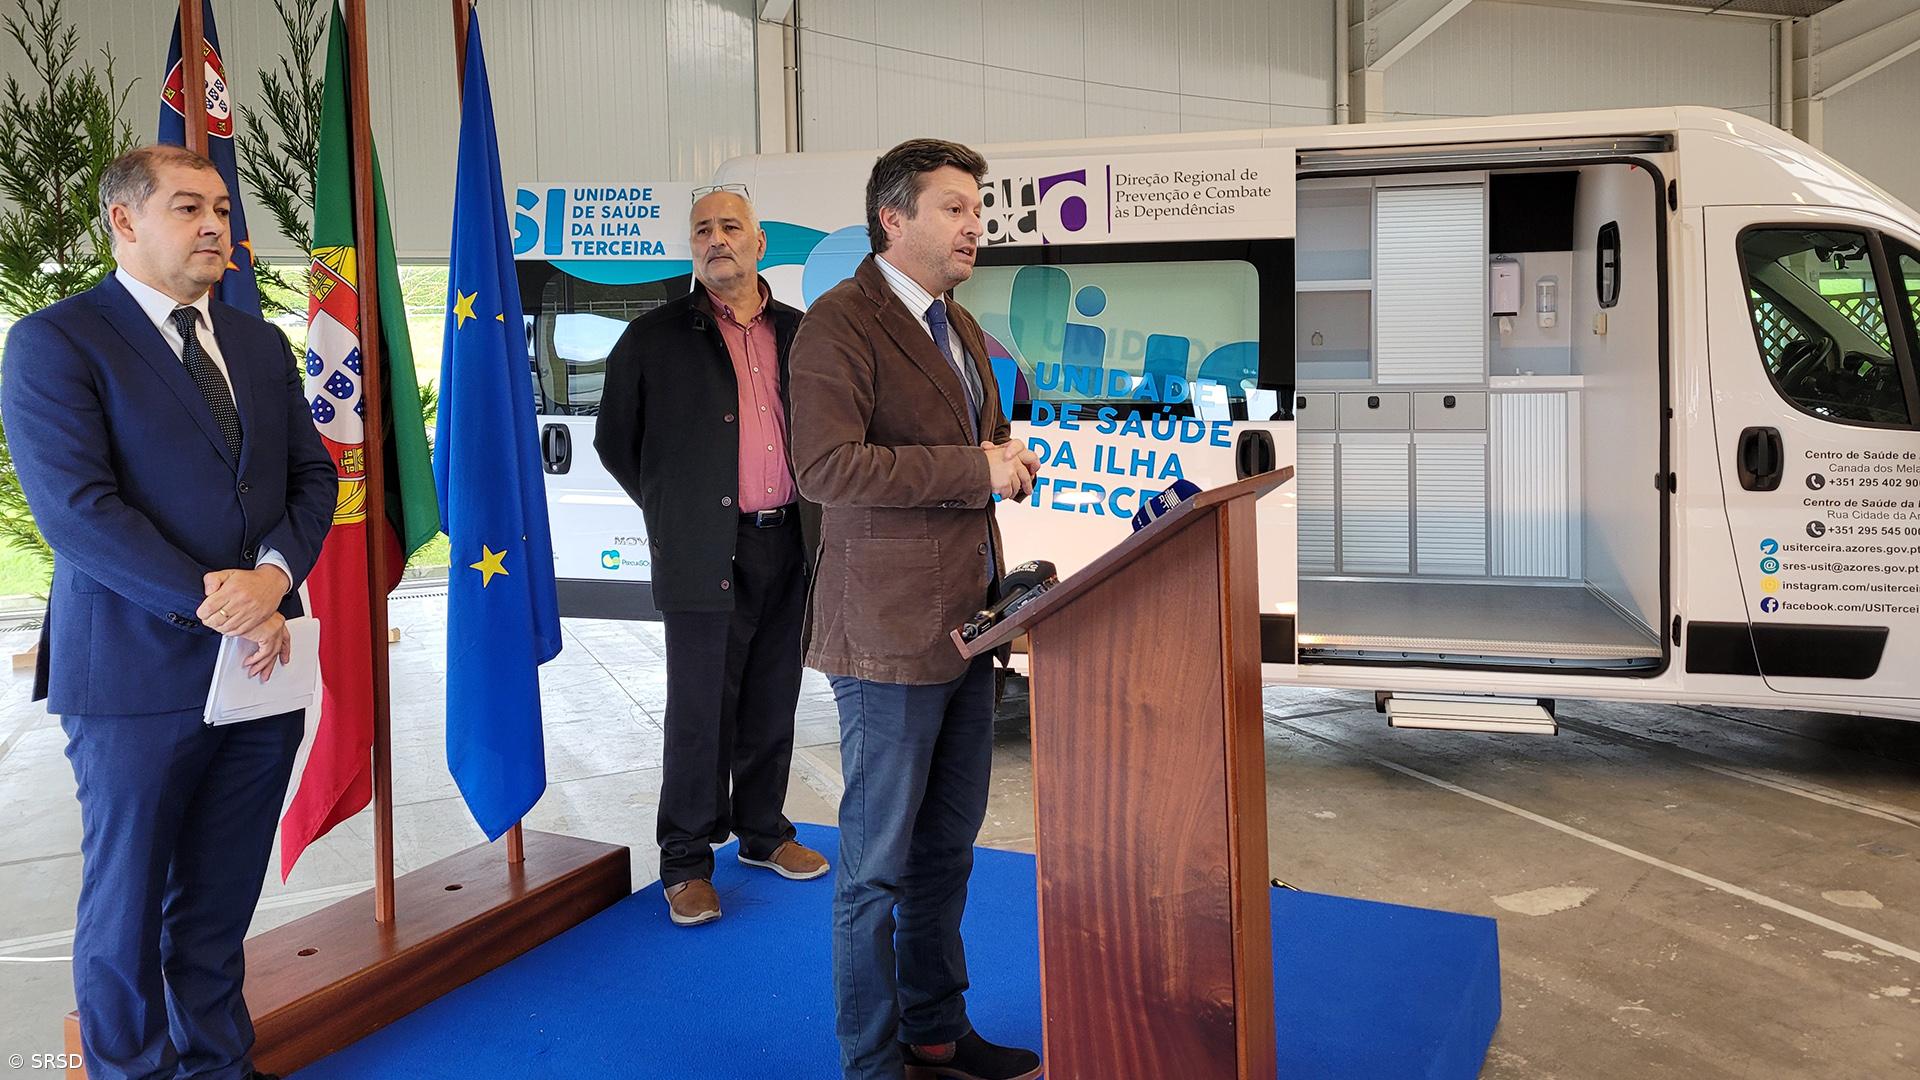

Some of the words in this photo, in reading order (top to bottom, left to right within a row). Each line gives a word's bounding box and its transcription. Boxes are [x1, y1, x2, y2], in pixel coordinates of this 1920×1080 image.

[1115, 172, 1169, 187] Direção
[1173, 168, 1236, 187] Regional
[1240, 168, 1259, 181] de
[573, 188, 653, 201] UNIDADE
[1115, 189, 1189, 204] Prevenção
[1193, 191, 1201, 200] e
[1205, 184, 1272, 199] Combate
[572, 206, 595, 218] DE
[601, 202, 660, 218] SAÚDE
[1114, 205, 1130, 218] às
[1134, 202, 1235, 220] Dependências
[571, 223, 595, 236] DA
[601, 223, 641, 236] ILHA
[571, 240, 666, 256] TERCEIRA
[1035, 361, 1218, 408] UNIDADE
[1030, 399, 1083, 430] DE
[1096, 406, 1234, 448] SAÚDE
[1028, 437, 1077, 469] DA
[1093, 444, 1185, 480] ILHA
[1804, 450, 1843, 460] Centro
[1846, 450, 1860, 460] de
[1863, 450, 1899, 460] Saúde
[1902, 451, 1916, 460] de
[1828, 463, 1871, 473] Canada
[1873, 463, 1893, 473] dos
[1829, 477, 1855, 487] +351
[1859, 478, 1879, 487] 295
[1882, 478, 1902, 487] 402
[1905, 478, 1920, 487] 90
[1803, 498, 1841, 507] Centro
[1844, 498, 1858, 507] de
[1861, 498, 1897, 508] Saúde
[1900, 499, 1915, 508] da
[1827, 510, 1849, 519] Rua
[1852, 510, 1890, 520] Cidade
[1893, 511, 1907, 520] da
[1828, 525, 1854, 535] +351
[1858, 526, 1878, 535] 295
[1881, 526, 1901, 536] 545
[1782, 562, 1919, 575] sres-usit@azores.gov.pt
[1782, 580, 1920, 593] instagram.com/usitercei
